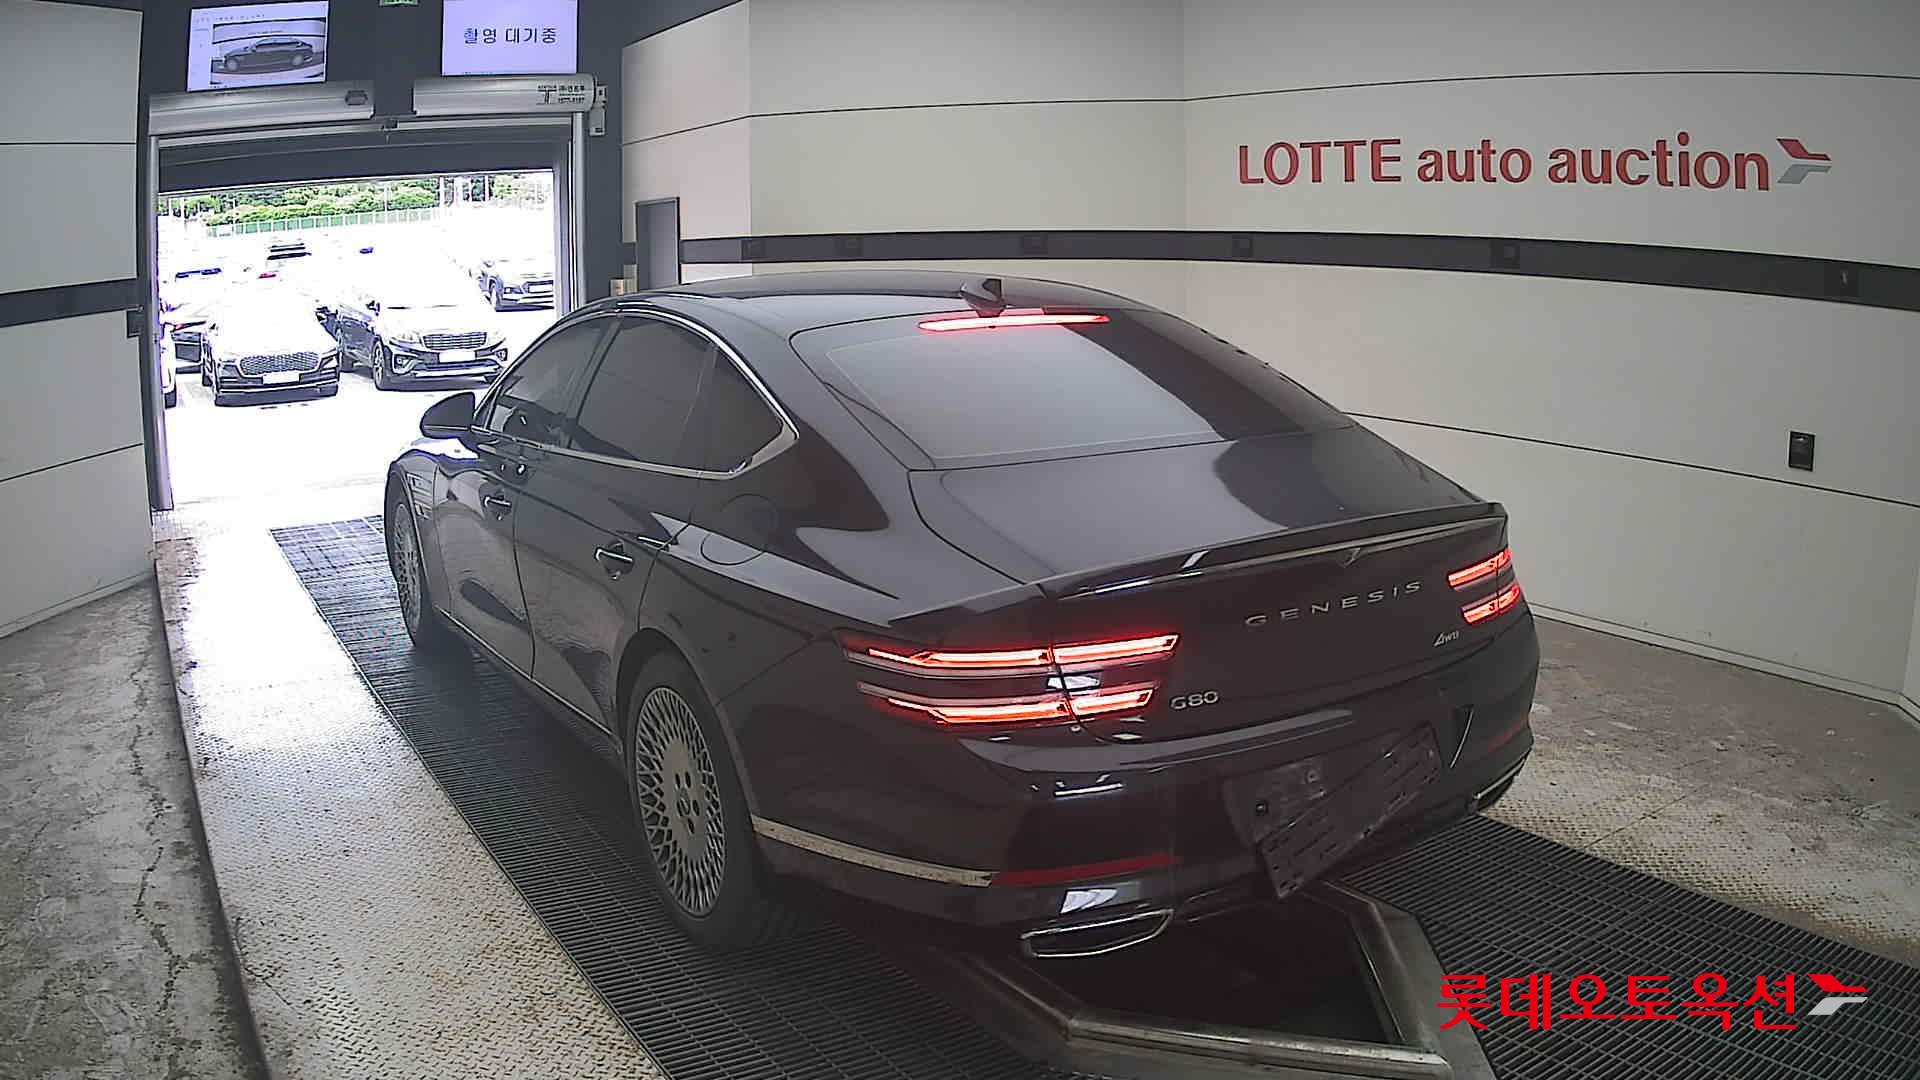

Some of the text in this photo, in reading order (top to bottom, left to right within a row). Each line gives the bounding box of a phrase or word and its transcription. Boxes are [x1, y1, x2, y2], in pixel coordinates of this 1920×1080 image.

[505, 28, 557, 45] 대기중
[1239, 131, 1769, 191] LOTTE auto auction
[1244, 581, 1422, 627] GENESIS
[1170, 691, 1219, 711] G80
